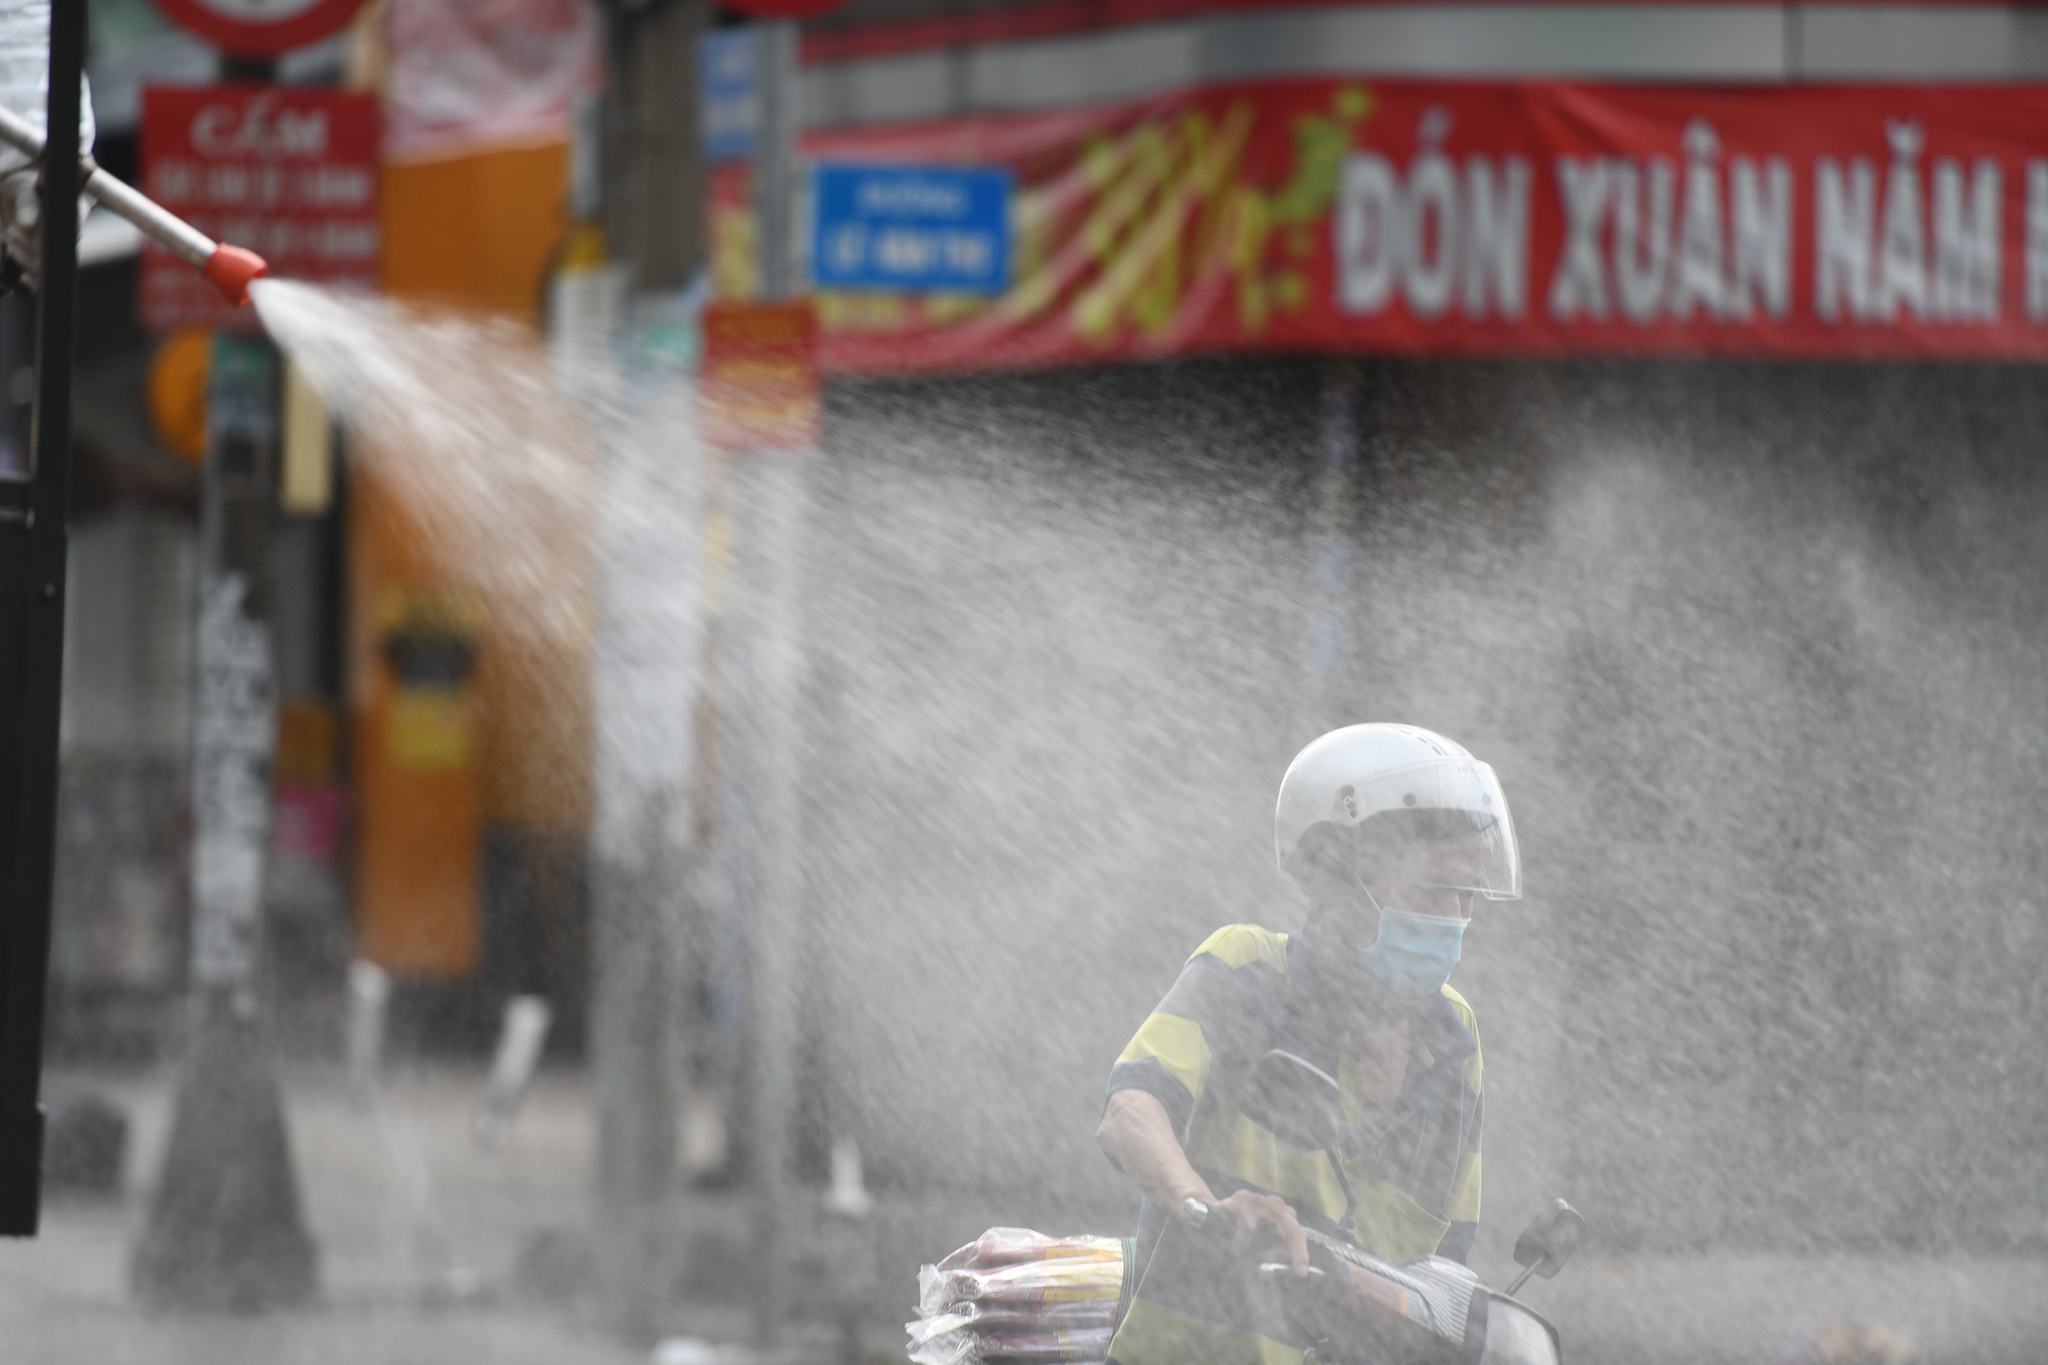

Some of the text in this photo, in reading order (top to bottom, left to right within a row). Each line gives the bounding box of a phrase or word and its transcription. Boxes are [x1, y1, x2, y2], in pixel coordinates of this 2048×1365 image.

[1335, 107, 1533, 320] ĐÓN
[1549, 120, 1791, 324] XUÂN
[1814, 118, 2001, 322] NĂM
